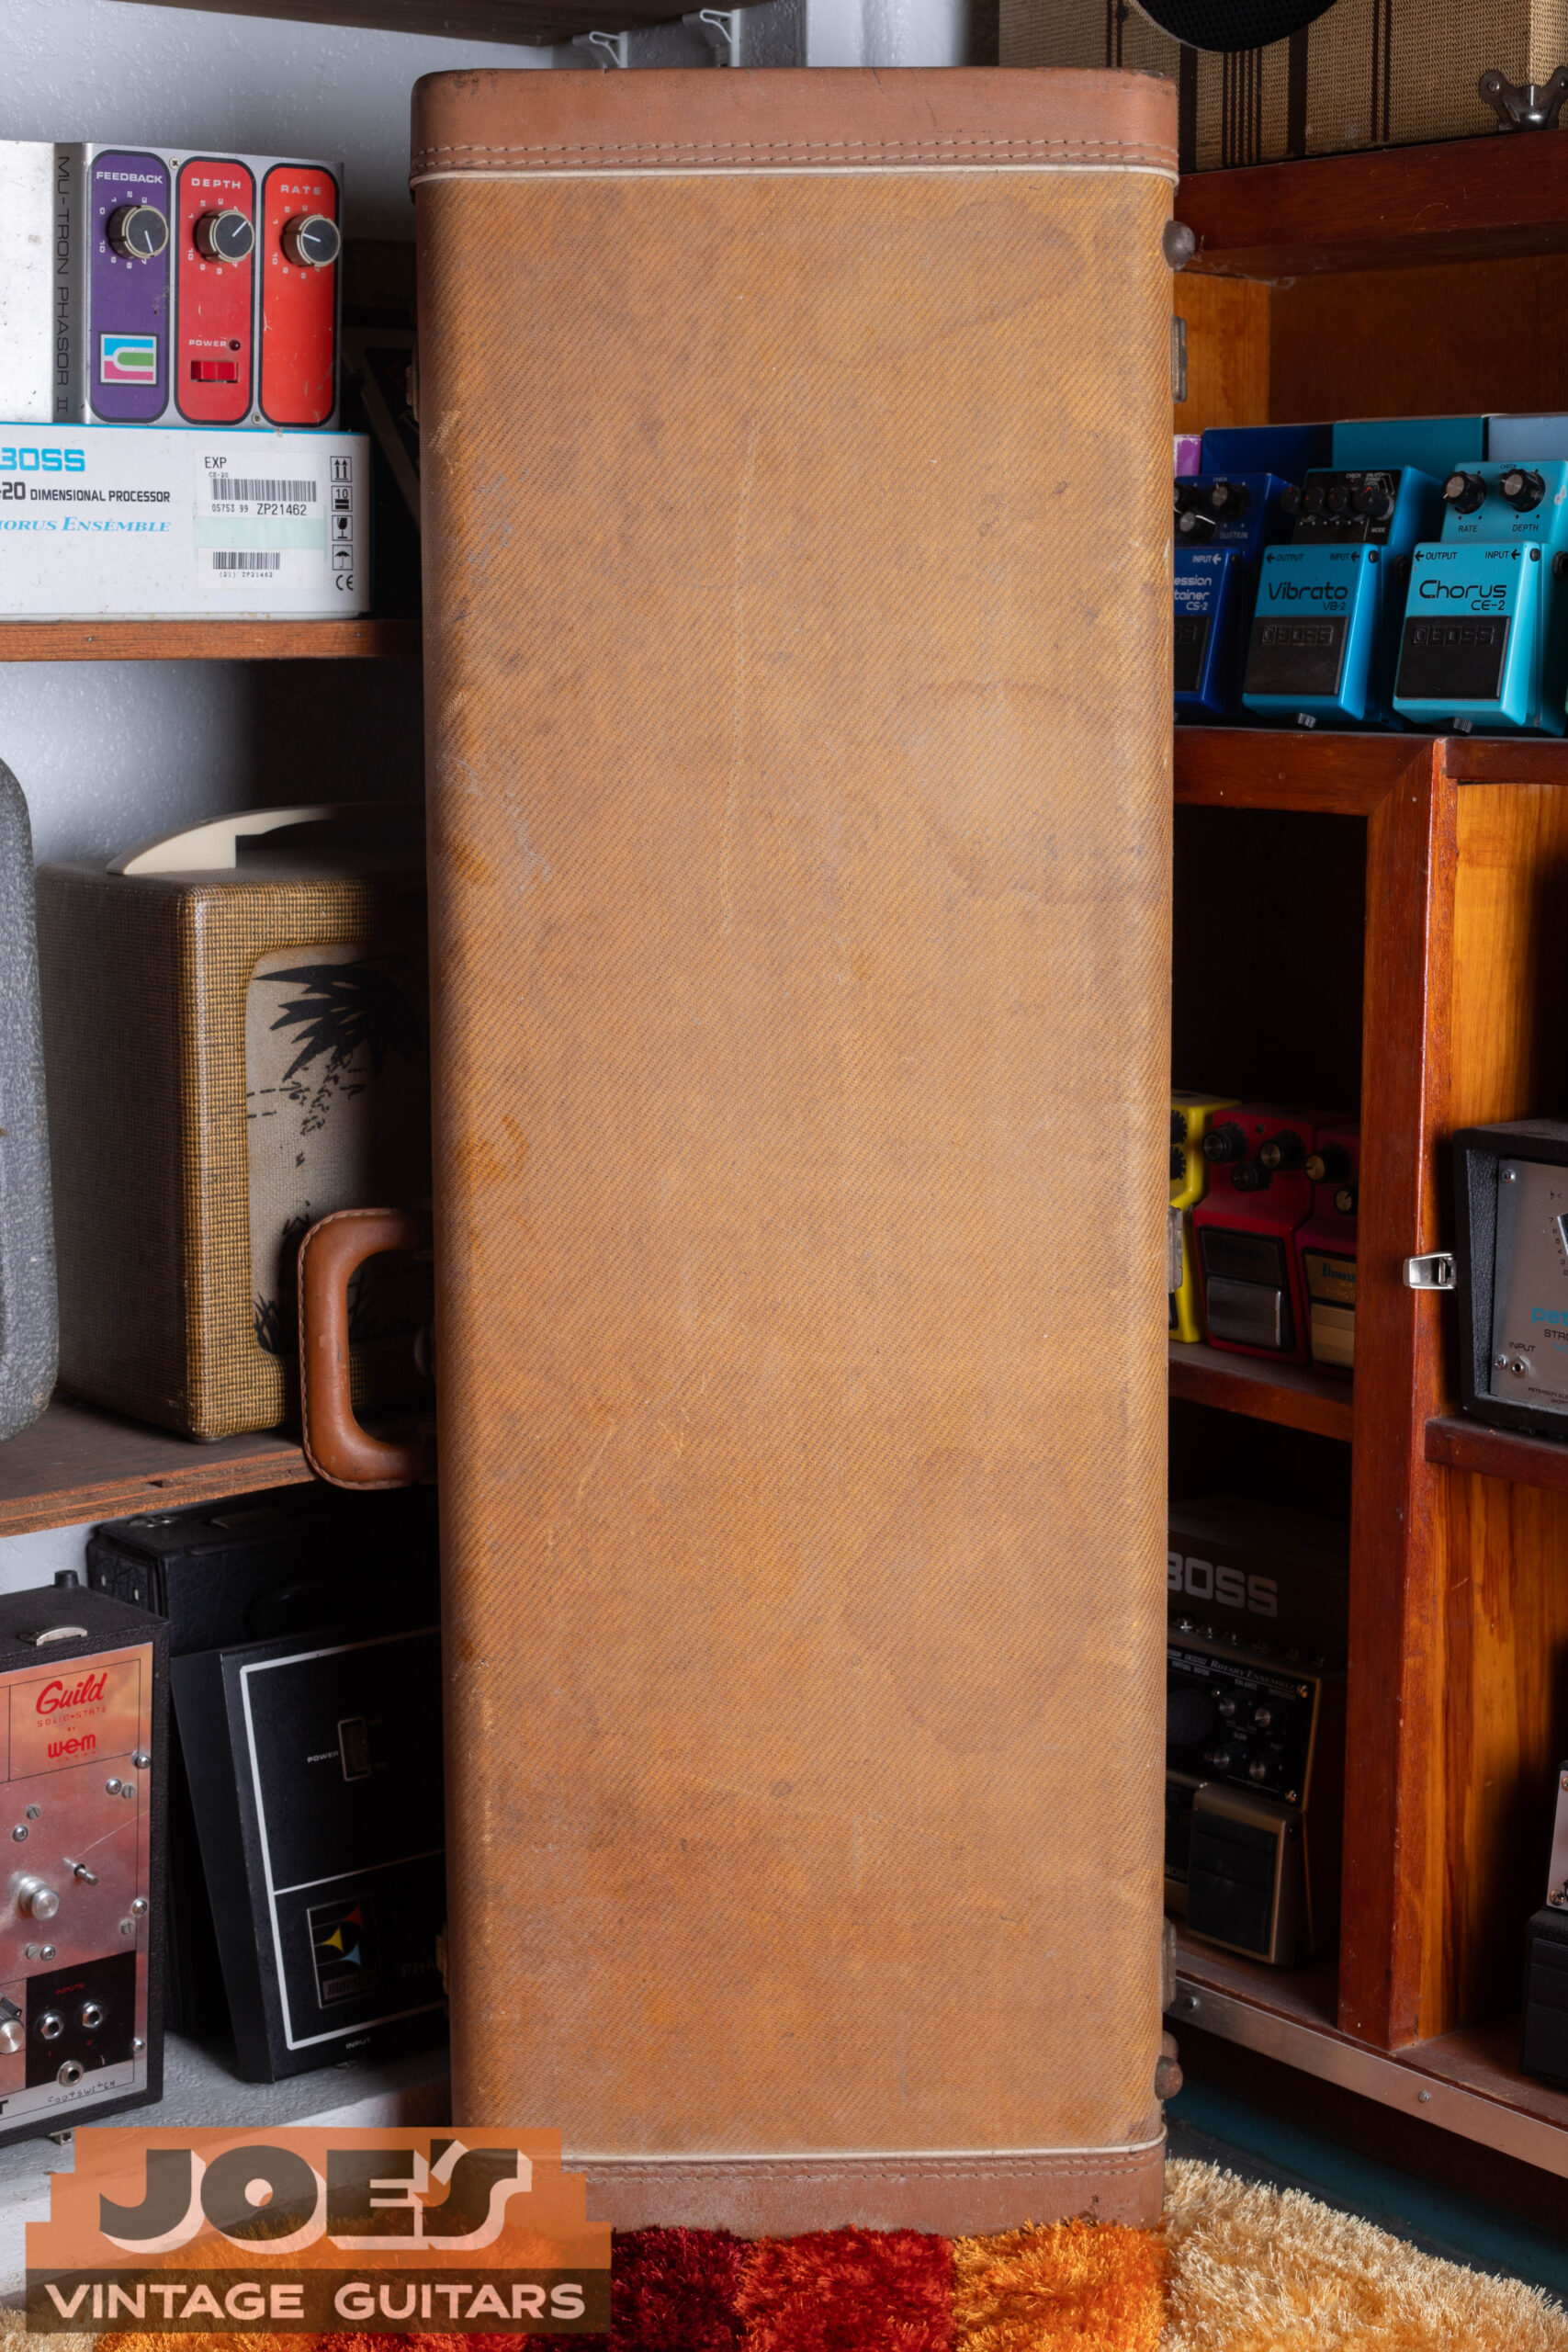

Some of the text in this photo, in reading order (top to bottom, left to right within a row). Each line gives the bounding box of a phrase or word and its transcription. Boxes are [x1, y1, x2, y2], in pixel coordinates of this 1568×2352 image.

[96, 171, 164, 184] FEEDBACK
[191, 177, 241, 189] DEPTH
[280, 184, 321, 195] RATE
[57, 156, 70, 413] MU-TRON PHASOR II
[188, 338, 227, 347] POWER
[0, 447, 85, 472] BOSS
[204, 456, 227, 469] EXP
[30, 489, 106, 502] DIMENSIONAL
[108, 491, 171, 503] PROCESSOR
[335, 489, 349, 499] 10
[211, 503, 307, 516] 05753 99 ZP21462
[0, 520, 58, 531] ORUS
[1458, 525, 1478, 533] RATE
[1512, 524, 1540, 532] DEPTH
[1191, 555, 1213, 563] INPUT
[1276, 553, 1304, 561] OUTPUT
[1330, 553, 1351, 561] INPUT
[1426, 552, 1459, 560] OUTPUT
[1484, 551, 1510, 560] INPUT
[1268, 582, 1348, 600] Vibrato
[1419, 580, 1507, 599] Chorus
[1185, 601, 1209, 611] CS-2
[1323, 602, 1347, 611] VB-2
[1471, 600, 1506, 611] CE-2
[1508, 1341, 1536, 1352] INPUT
[1528, 1386, 1558, 1397] PETERSON
[1168, 1551, 1279, 1619] BOSS
[35, 1672, 107, 1715] Guild
[307, 1750, 339, 1763] POWER
[345, 2037, 371, 2050] INPUT
